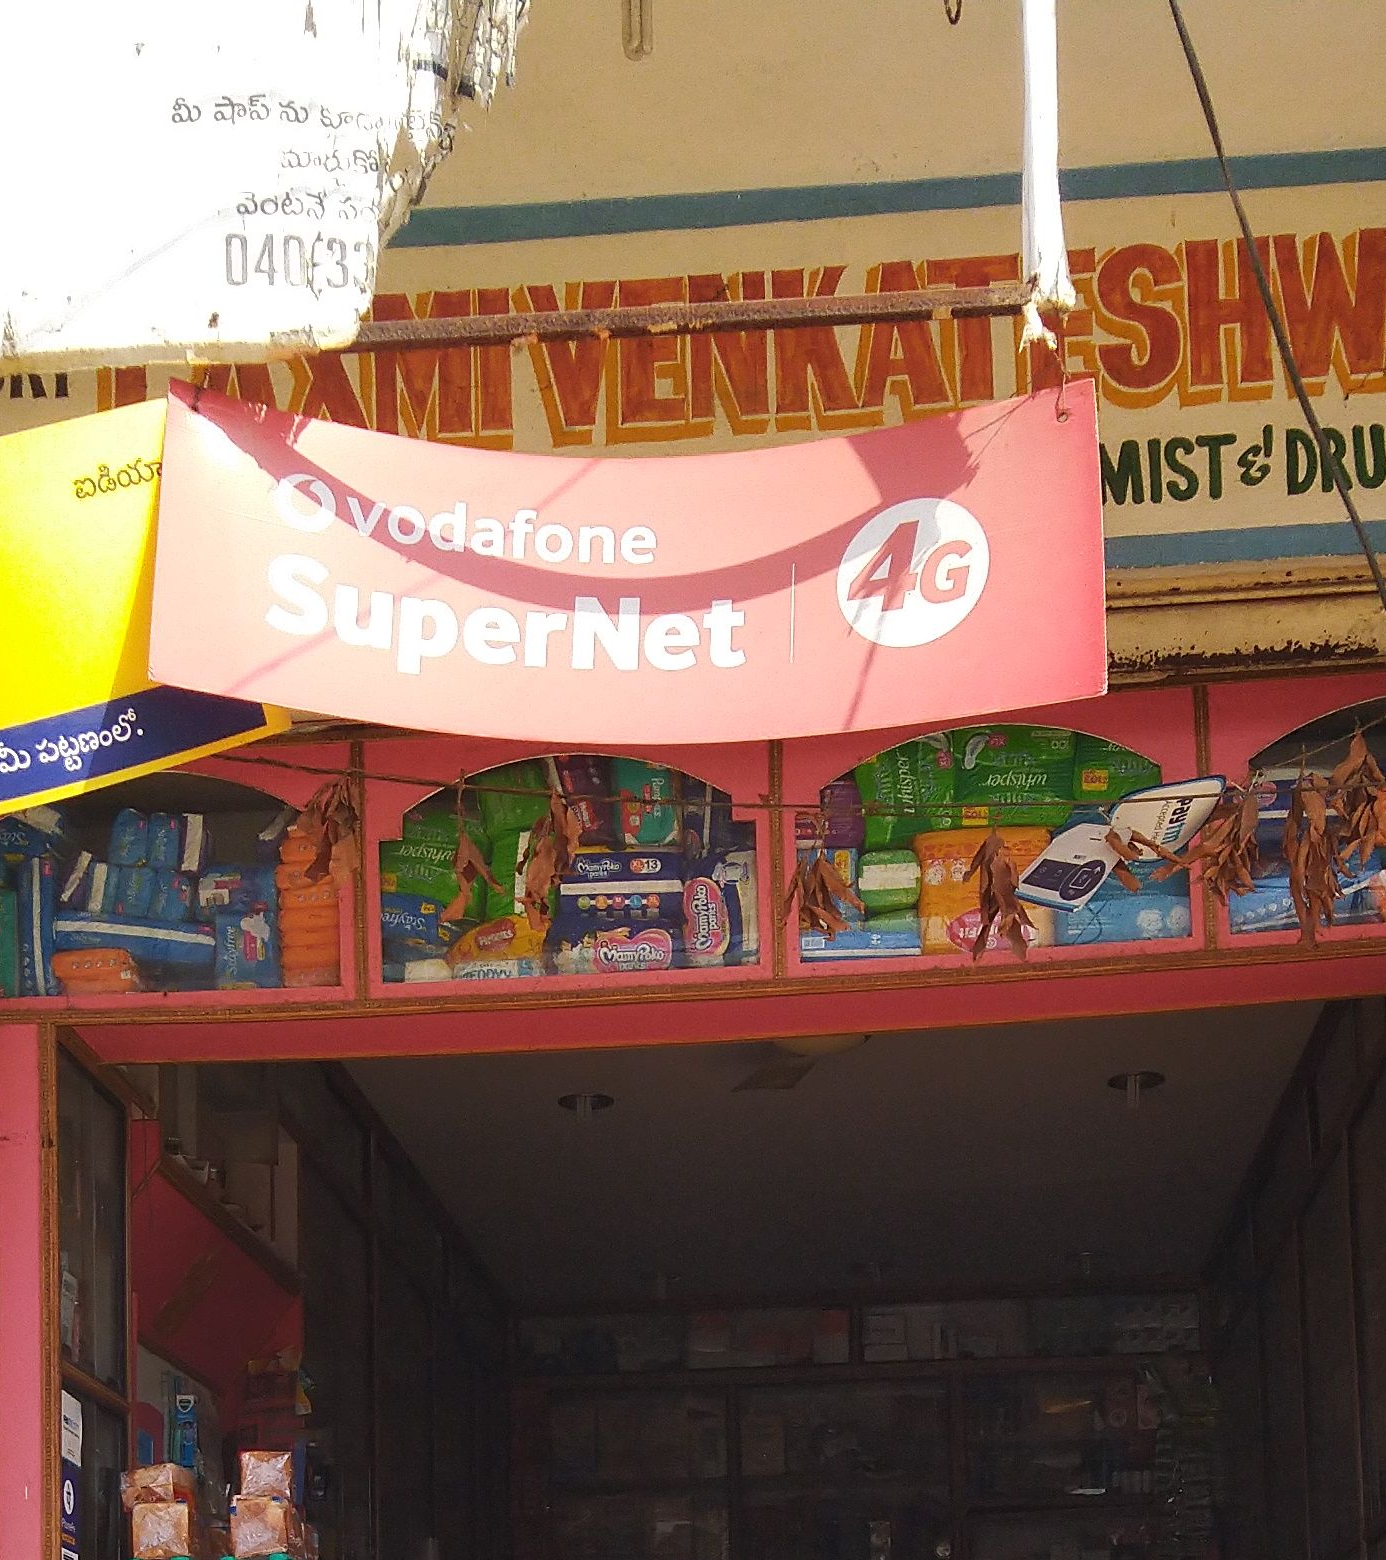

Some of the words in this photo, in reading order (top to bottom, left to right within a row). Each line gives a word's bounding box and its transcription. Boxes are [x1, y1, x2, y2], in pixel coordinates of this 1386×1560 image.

[1099, 433, 1236, 506] MIST
[347, 500, 658, 566] vodafone
[266, 554, 748, 672] SuperNet
[847, 520, 972, 613] 4G
